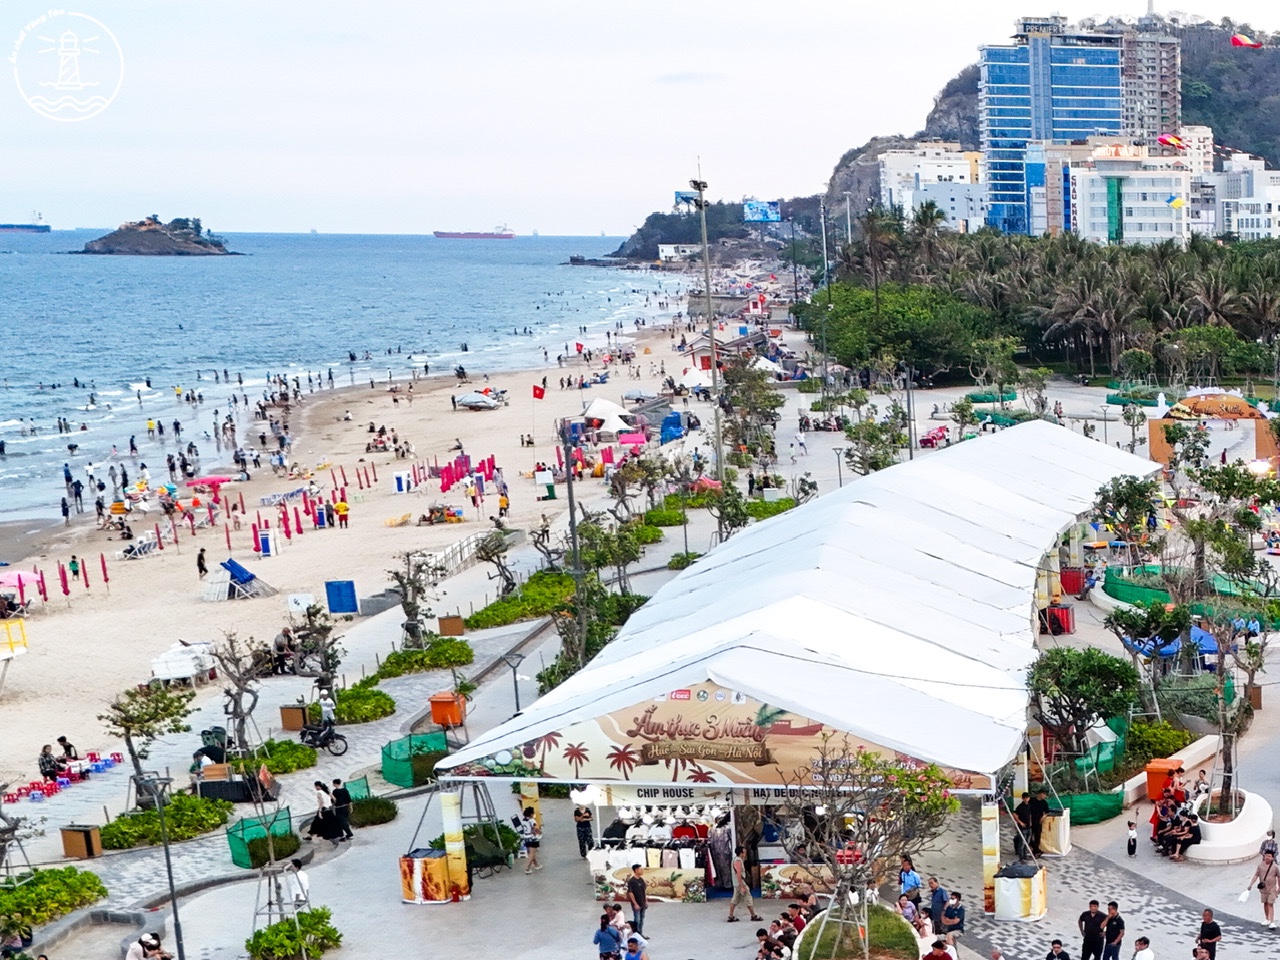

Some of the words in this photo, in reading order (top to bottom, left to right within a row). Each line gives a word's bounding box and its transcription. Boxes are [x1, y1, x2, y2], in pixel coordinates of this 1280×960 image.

[1025, 24, 1058, 34] PREMIER
[702, 714, 721, 741] 3
[637, 788, 661, 798] CHIP
[663, 788, 695, 798] HOUSE
